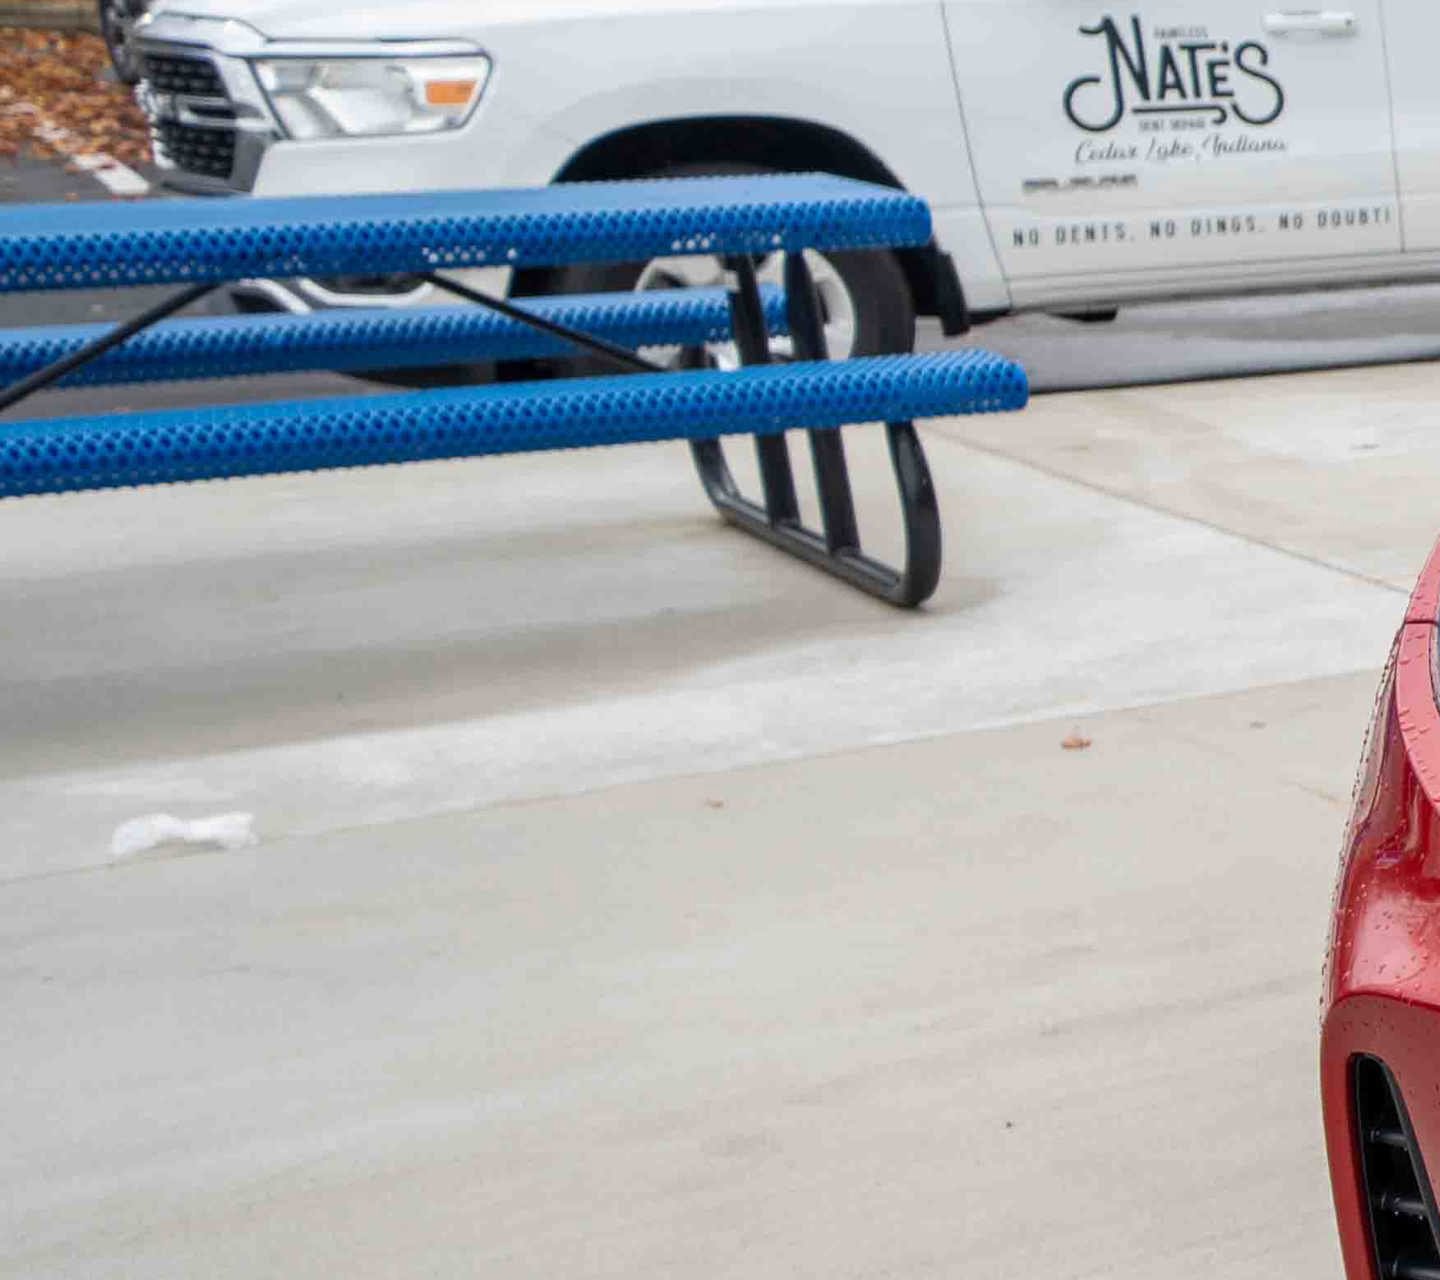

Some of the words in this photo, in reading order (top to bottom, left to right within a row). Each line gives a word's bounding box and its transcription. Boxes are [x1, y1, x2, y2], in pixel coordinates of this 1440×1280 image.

[1063, 14, 1285, 132] NATE'S
[1013, 227, 1040, 247] NO
[1150, 219, 1176, 238] NO
[1278, 211, 1303, 230] NO
